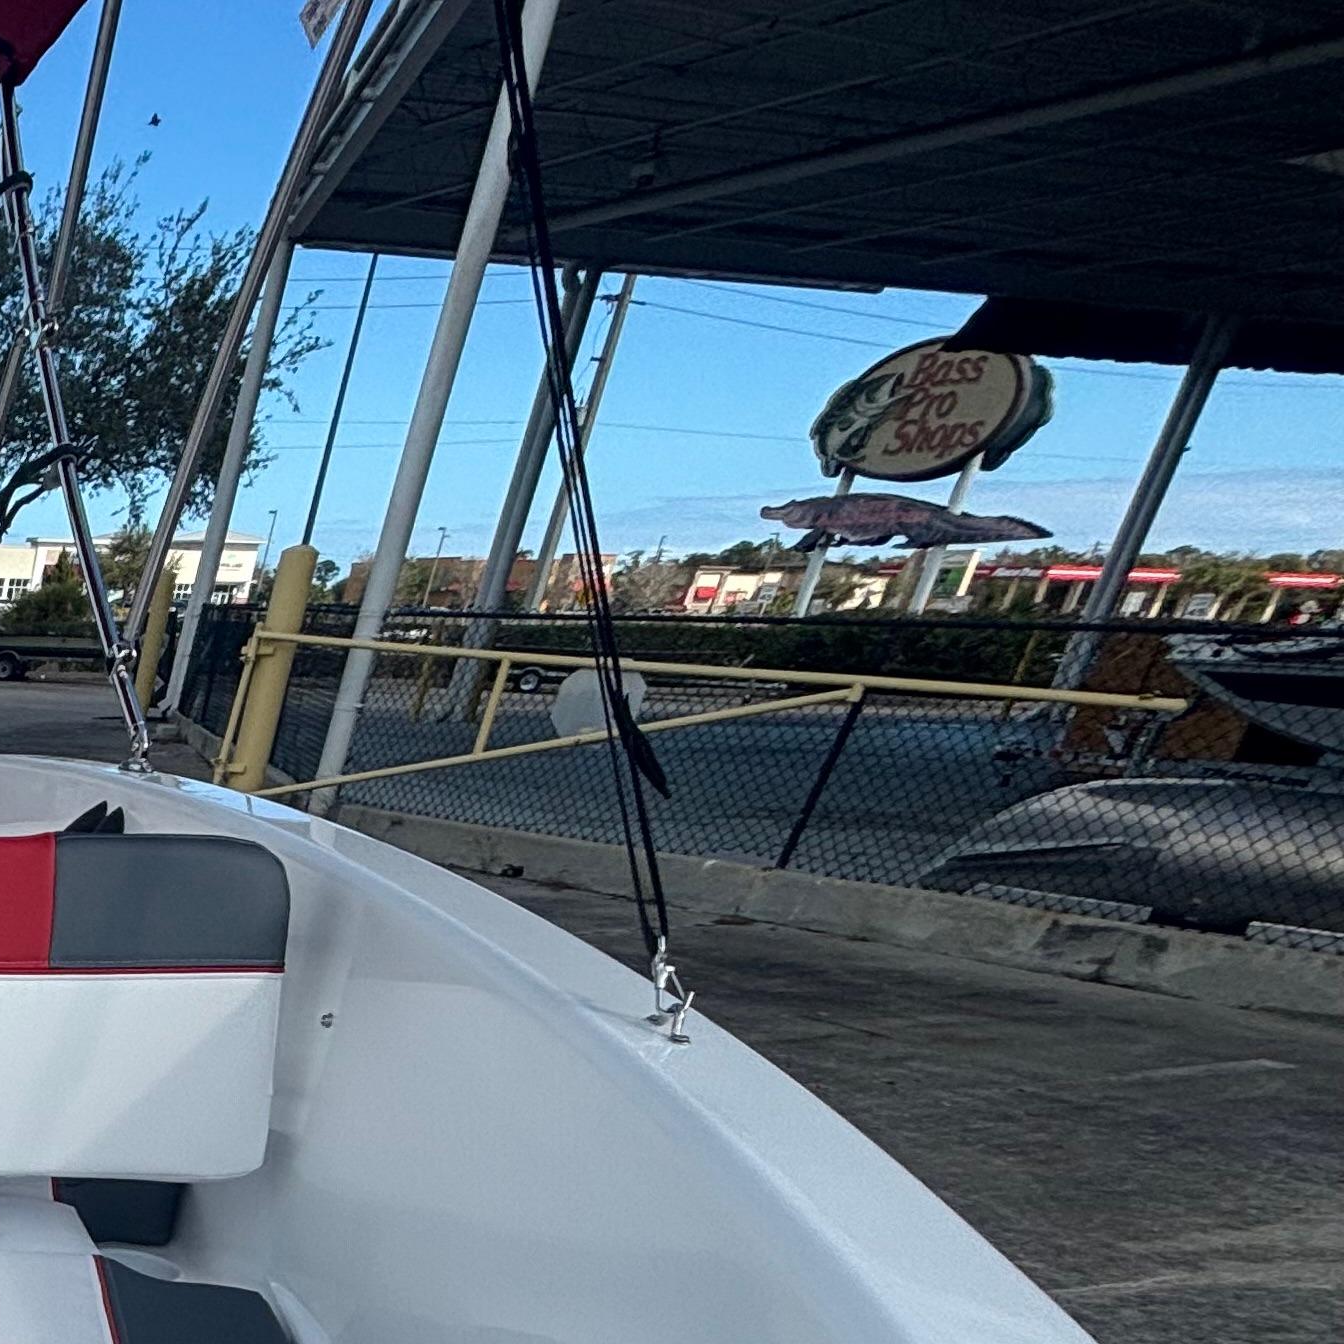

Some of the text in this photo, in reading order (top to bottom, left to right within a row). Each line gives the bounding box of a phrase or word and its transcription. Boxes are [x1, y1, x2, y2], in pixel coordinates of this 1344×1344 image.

[904, 350, 989, 388] Bass
[893, 387, 959, 421] Pro
[882, 418, 984, 458] Shops
